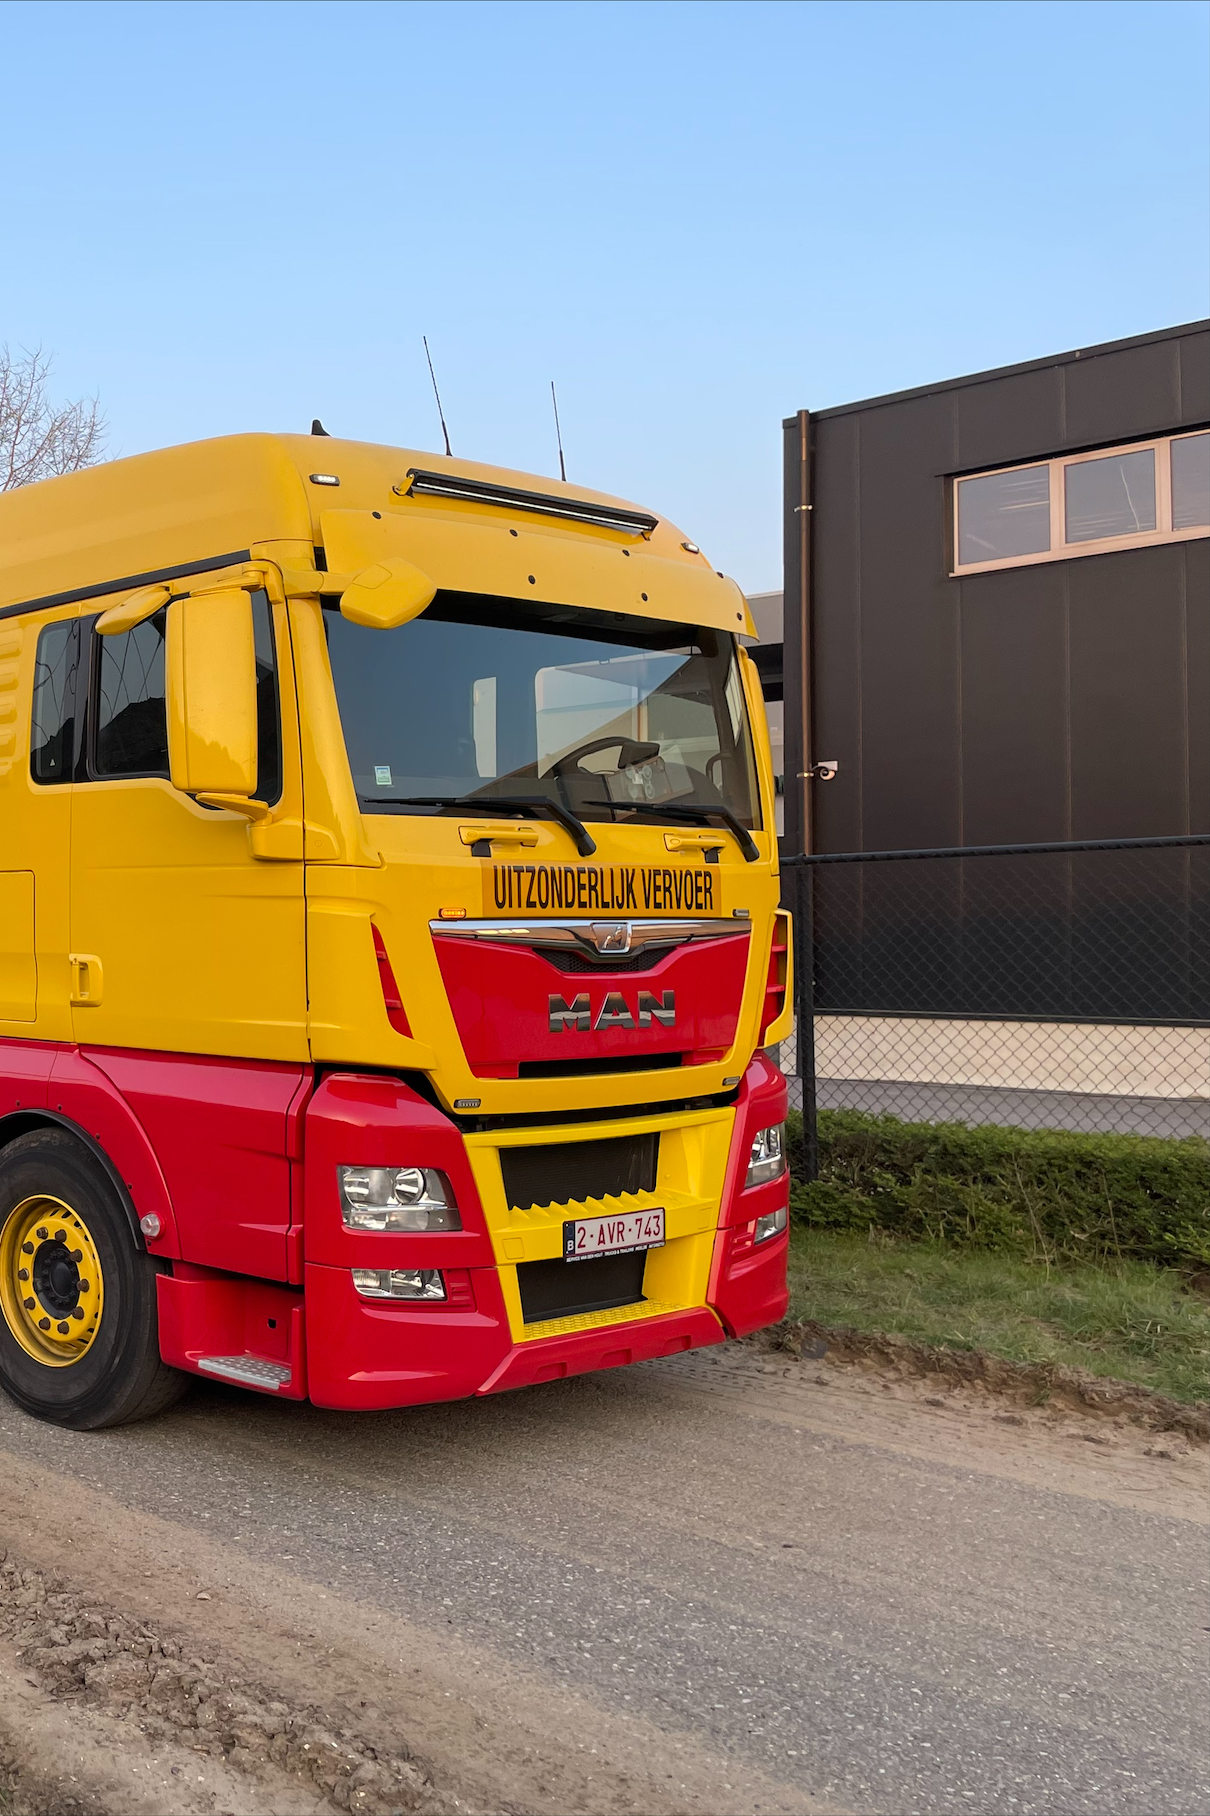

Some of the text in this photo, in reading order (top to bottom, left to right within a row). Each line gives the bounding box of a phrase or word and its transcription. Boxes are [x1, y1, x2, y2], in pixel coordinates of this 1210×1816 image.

[493, 865, 714, 910] UITZONDERLIJK VERVOER
[548, 990, 676, 1033] MAN
[567, 1214, 661, 1251] B 2-AVR-743
